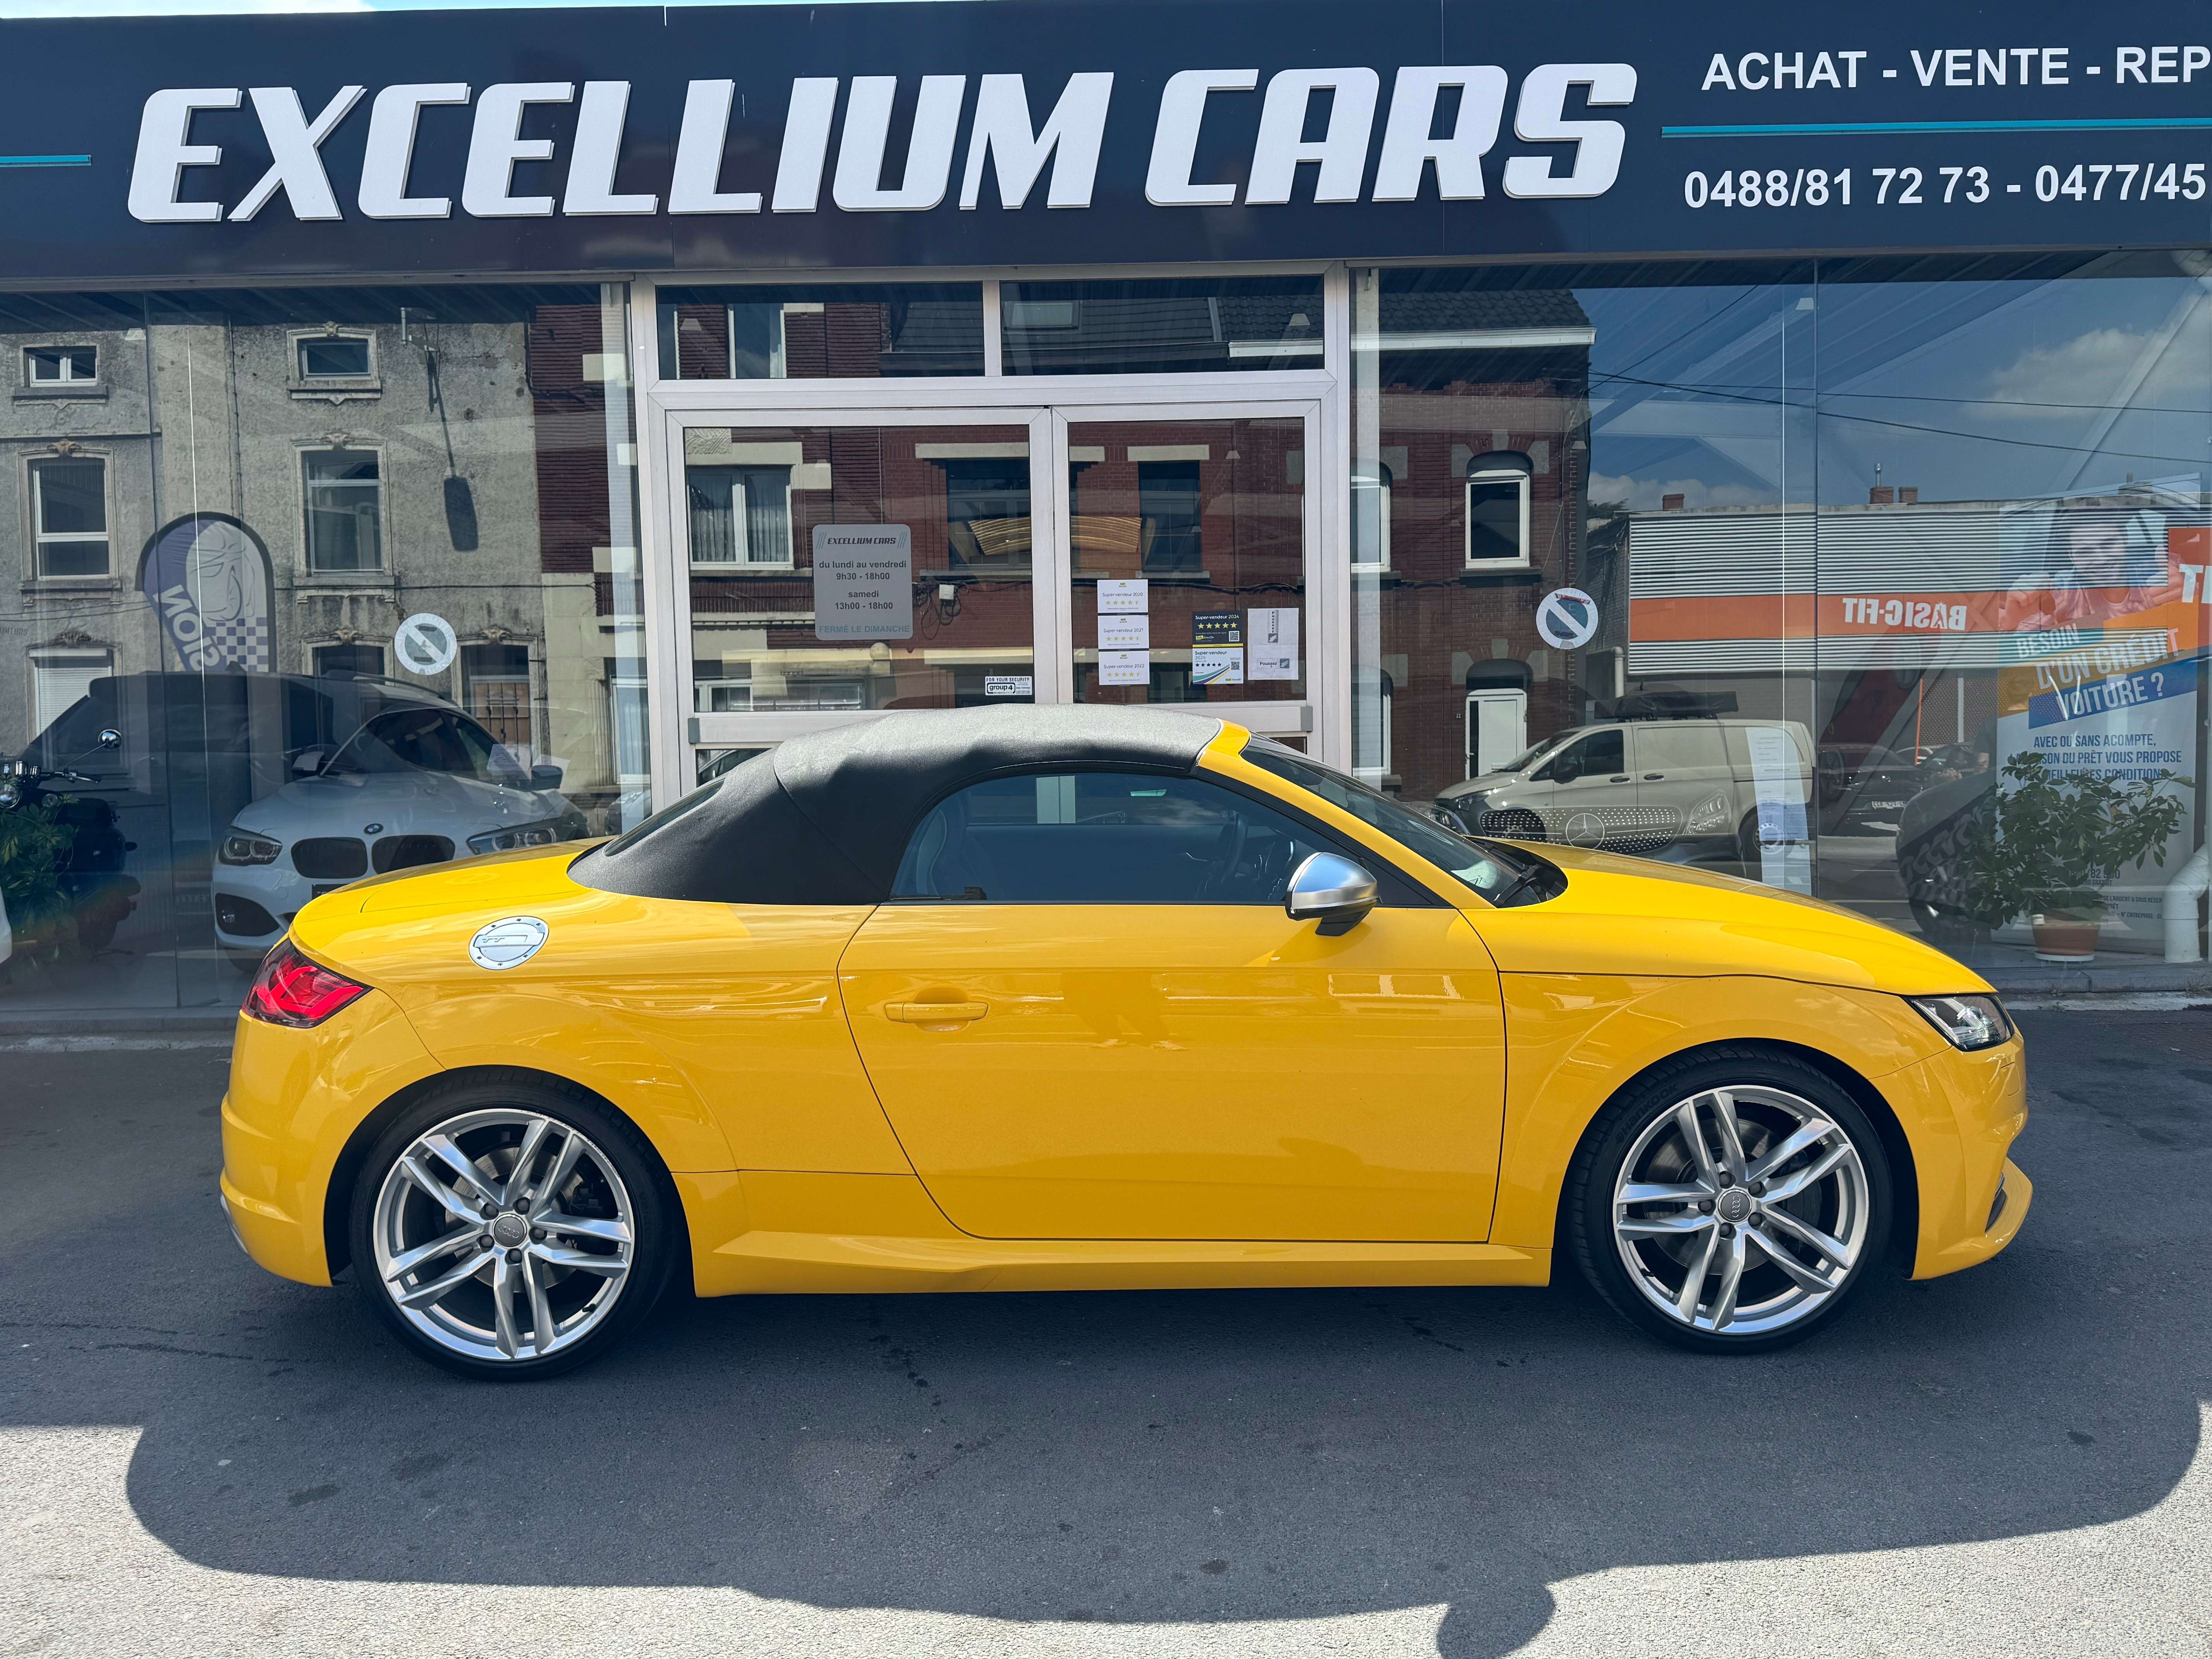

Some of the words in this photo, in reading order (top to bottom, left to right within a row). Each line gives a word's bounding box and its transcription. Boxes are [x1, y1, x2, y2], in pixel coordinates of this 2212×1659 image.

[1702, 51, 1867, 90] ACHAT
[1882, 69, 1897, 77] -
[1910, 47, 2069, 87] VENTE
[2087, 66, 2101, 74] -
[2116, 46, 2212, 84] REP
[128, 72, 1114, 223] EXCELLIUM
[1145, 63, 1638, 206] CARS
[1684, 168, 1851, 208] 0488/81
[1872, 167, 1923, 204] 72
[1939, 166, 1990, 203] 73
[2035, 163, 2206, 202] 0477/45
[2016, 623, 2080, 659] BESOIN
[2094, 628, 2179, 674] CRÉDIT
[2056, 676, 2148, 720] VOITURE
[2151, 672, 2164, 697] ?
[2033, 736, 2057, 748] AVEC
[2060, 735, 2072, 747] OU
[2075, 735, 2100, 747] SANS
[2103, 733, 2156, 747] ACOMPTE,
[2063, 752, 2075, 764] DU
[2078, 749, 2103, 764] PRÊT
[2105, 751, 2133, 763] VOUS
[2136, 750, 2182, 763] PROPOSE
